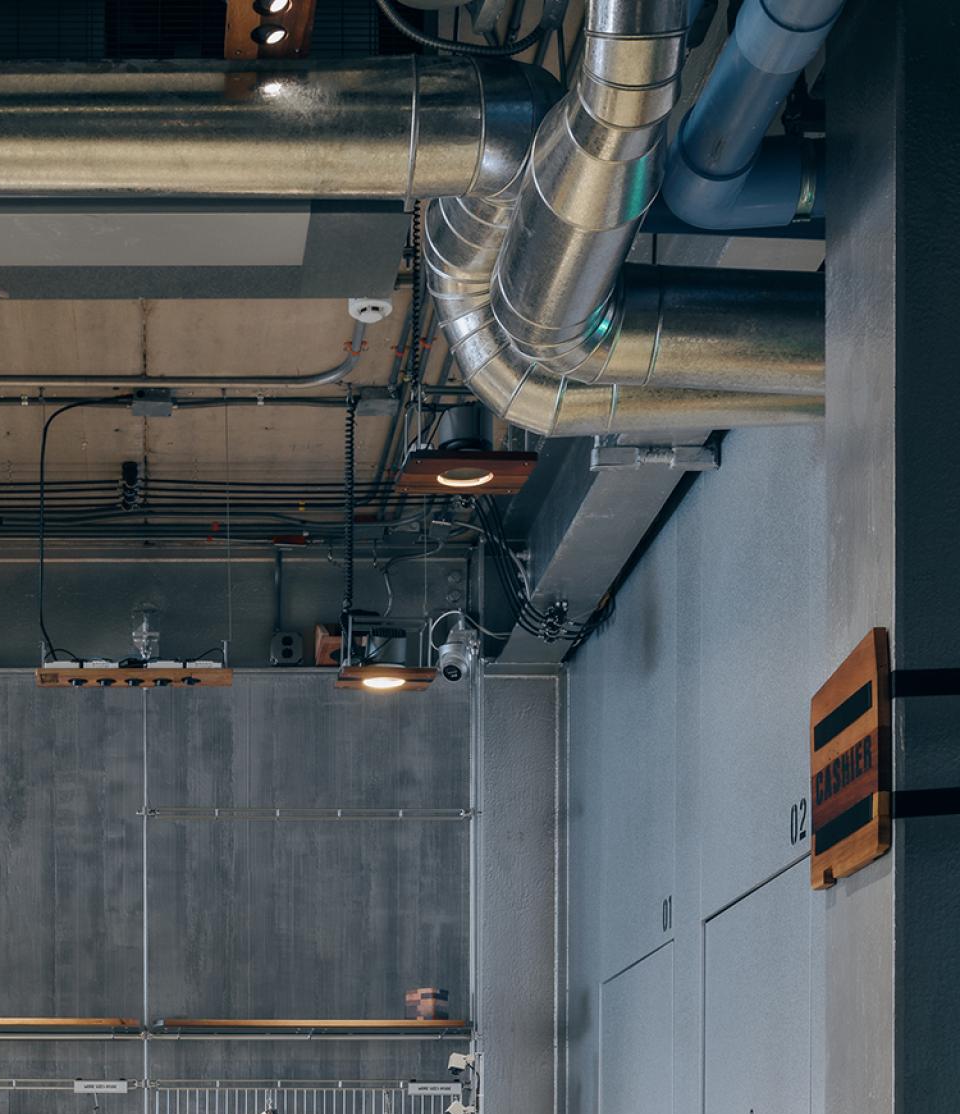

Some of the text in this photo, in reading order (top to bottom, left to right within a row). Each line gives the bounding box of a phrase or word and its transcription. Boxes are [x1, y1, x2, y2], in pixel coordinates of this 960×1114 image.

[816, 735, 872, 806] CASHIER
[790, 797, 807, 845] 02
[662, 895, 672, 932] 01
